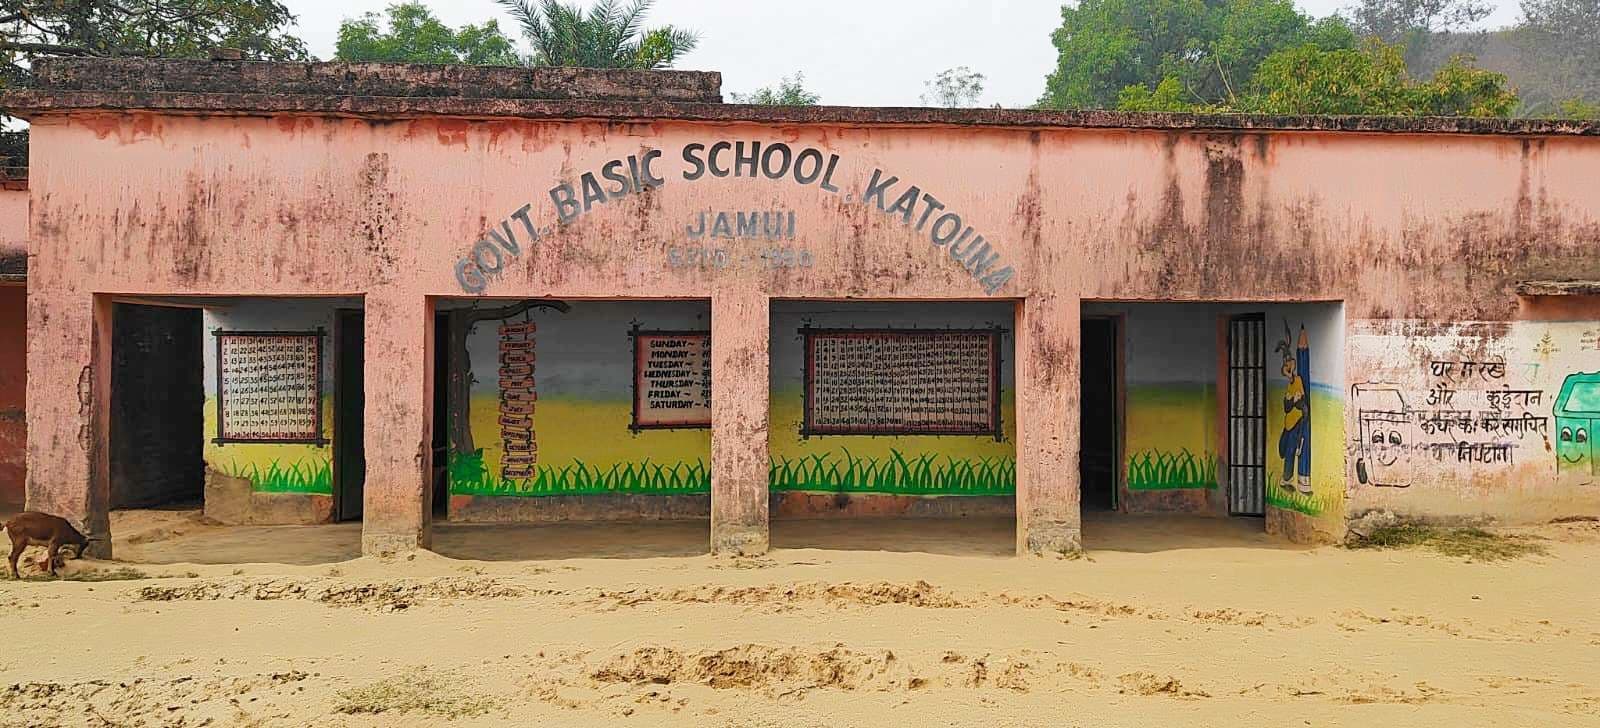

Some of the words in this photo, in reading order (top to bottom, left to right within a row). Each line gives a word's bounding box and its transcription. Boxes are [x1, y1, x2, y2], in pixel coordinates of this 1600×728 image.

[549, 149, 665, 225] BASIC
[862, 168, 1016, 296] KATOUNA
[686, 210, 796, 240] JAMUI
[650, 340, 688, 348] SUNDAY
[1430, 360, 1455, 384] घर
[648, 390, 681, 398] FRIDAY
[650, 400, 694, 408] SATURDAY
[1426, 383, 1456, 412] और
